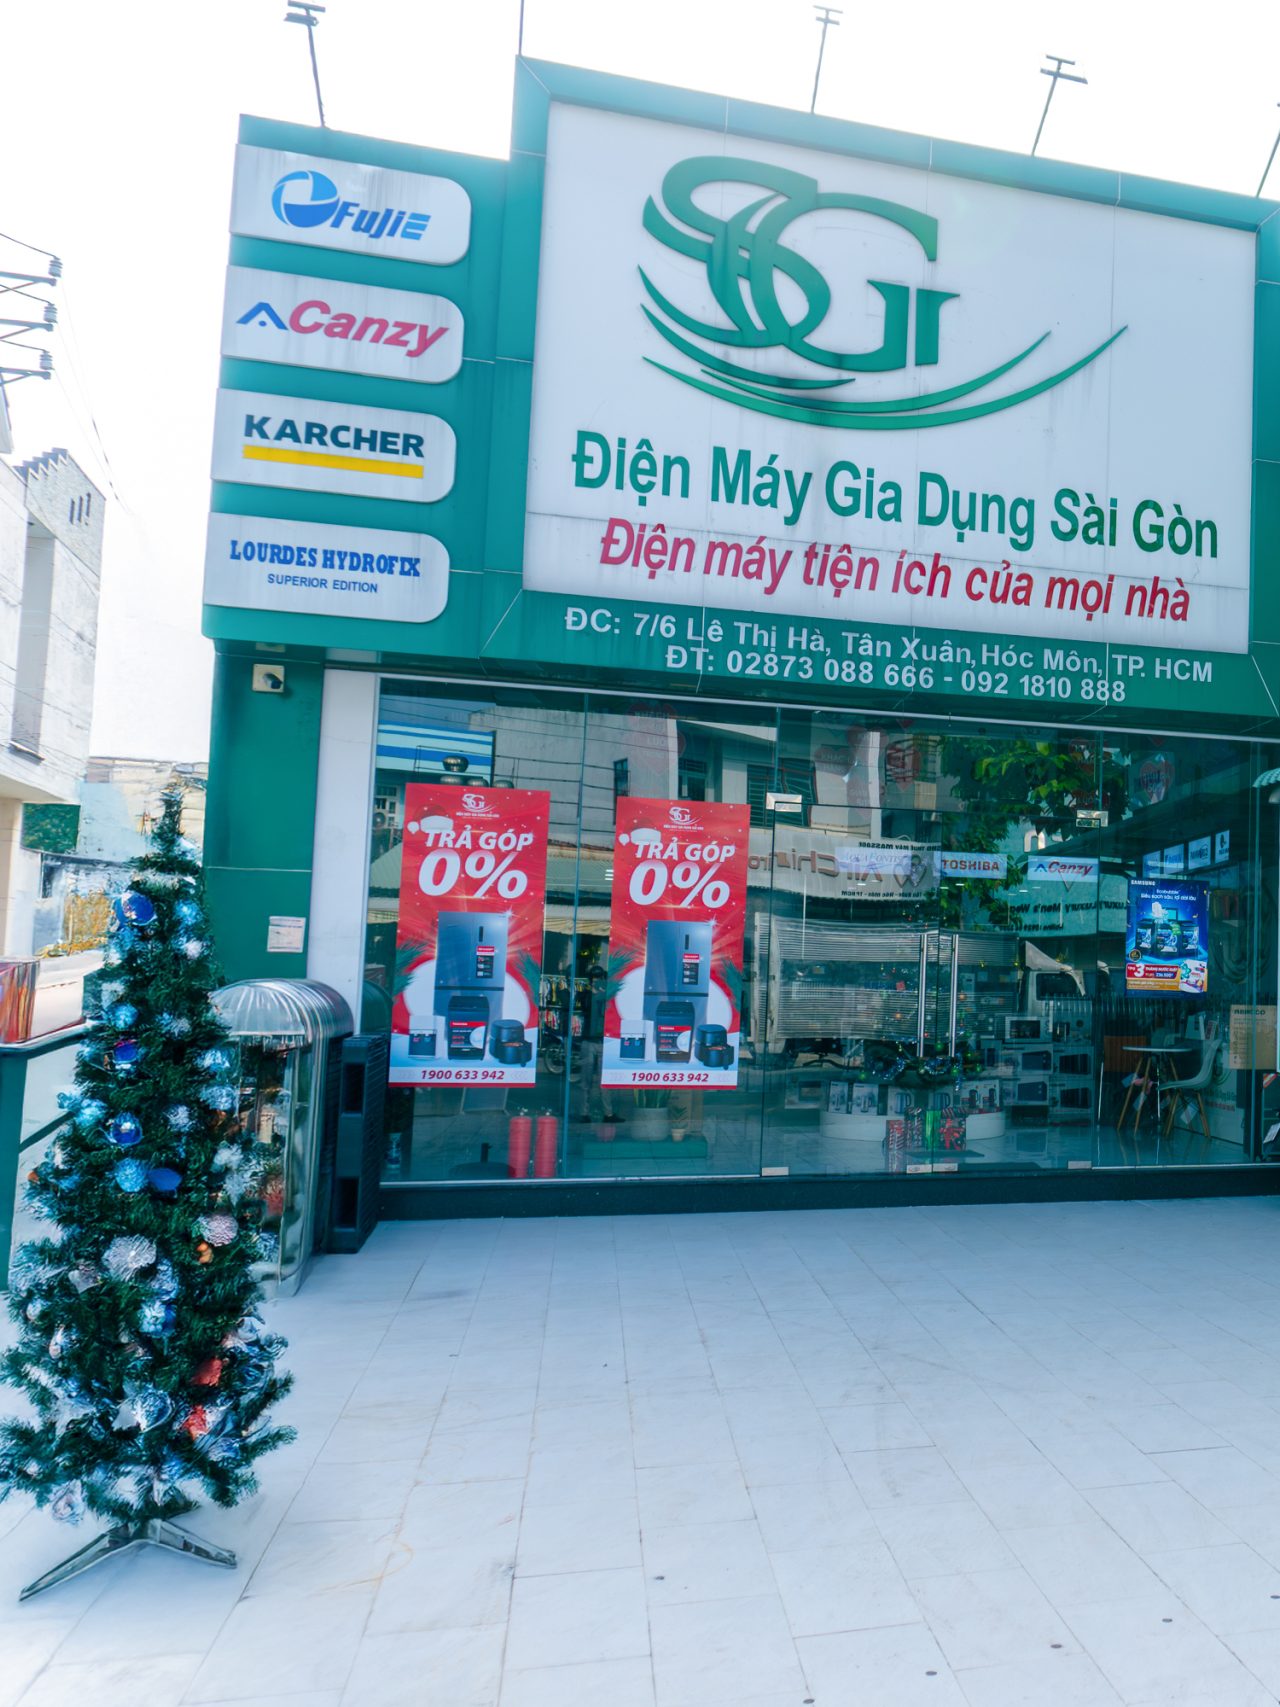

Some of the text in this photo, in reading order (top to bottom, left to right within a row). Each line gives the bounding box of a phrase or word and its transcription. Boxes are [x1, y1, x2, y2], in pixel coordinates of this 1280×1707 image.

[289, 300, 449, 358] Canzy
[244, 414, 425, 458] KARCHER
[572, 430, 1218, 558] Điện Máy Gia Dụng Sài Gòn
[230, 539, 421, 577] LOURDES HYDROFIX
[600, 517, 1191, 621] Điện máy tiện ích của mọi nhà
[267, 573, 378, 593] SUPERIOR EDITION
[564, 606, 1213, 683] ĐC: 7/6 Lê Thị Hà, Tân Xuân, Hóc Môn, TP. HCM
[665, 645, 714, 672] ĐT:
[726, 650, 814, 679] 02873
[824, 656, 874, 684] 088
[884, 663, 934, 689] 666
[961, 669, 1009, 695] 092
[1019, 673, 1072, 698] 1810
[1080, 677, 1126, 702] 888
[425, 824, 534, 851] TRẢ GÓP
[635, 837, 736, 862] TRẢ GÓP
[418, 848, 528, 899] 0%
[629, 859, 731, 908] 0%
[942, 859, 999, 871] TOSHIBA
[1048, 860, 1093, 876] Canzy
[1134, 964, 1145, 977] 3
[421, 1069, 505, 1080] 1900 633 942
[632, 1072, 709, 1082] 1900 633 942
